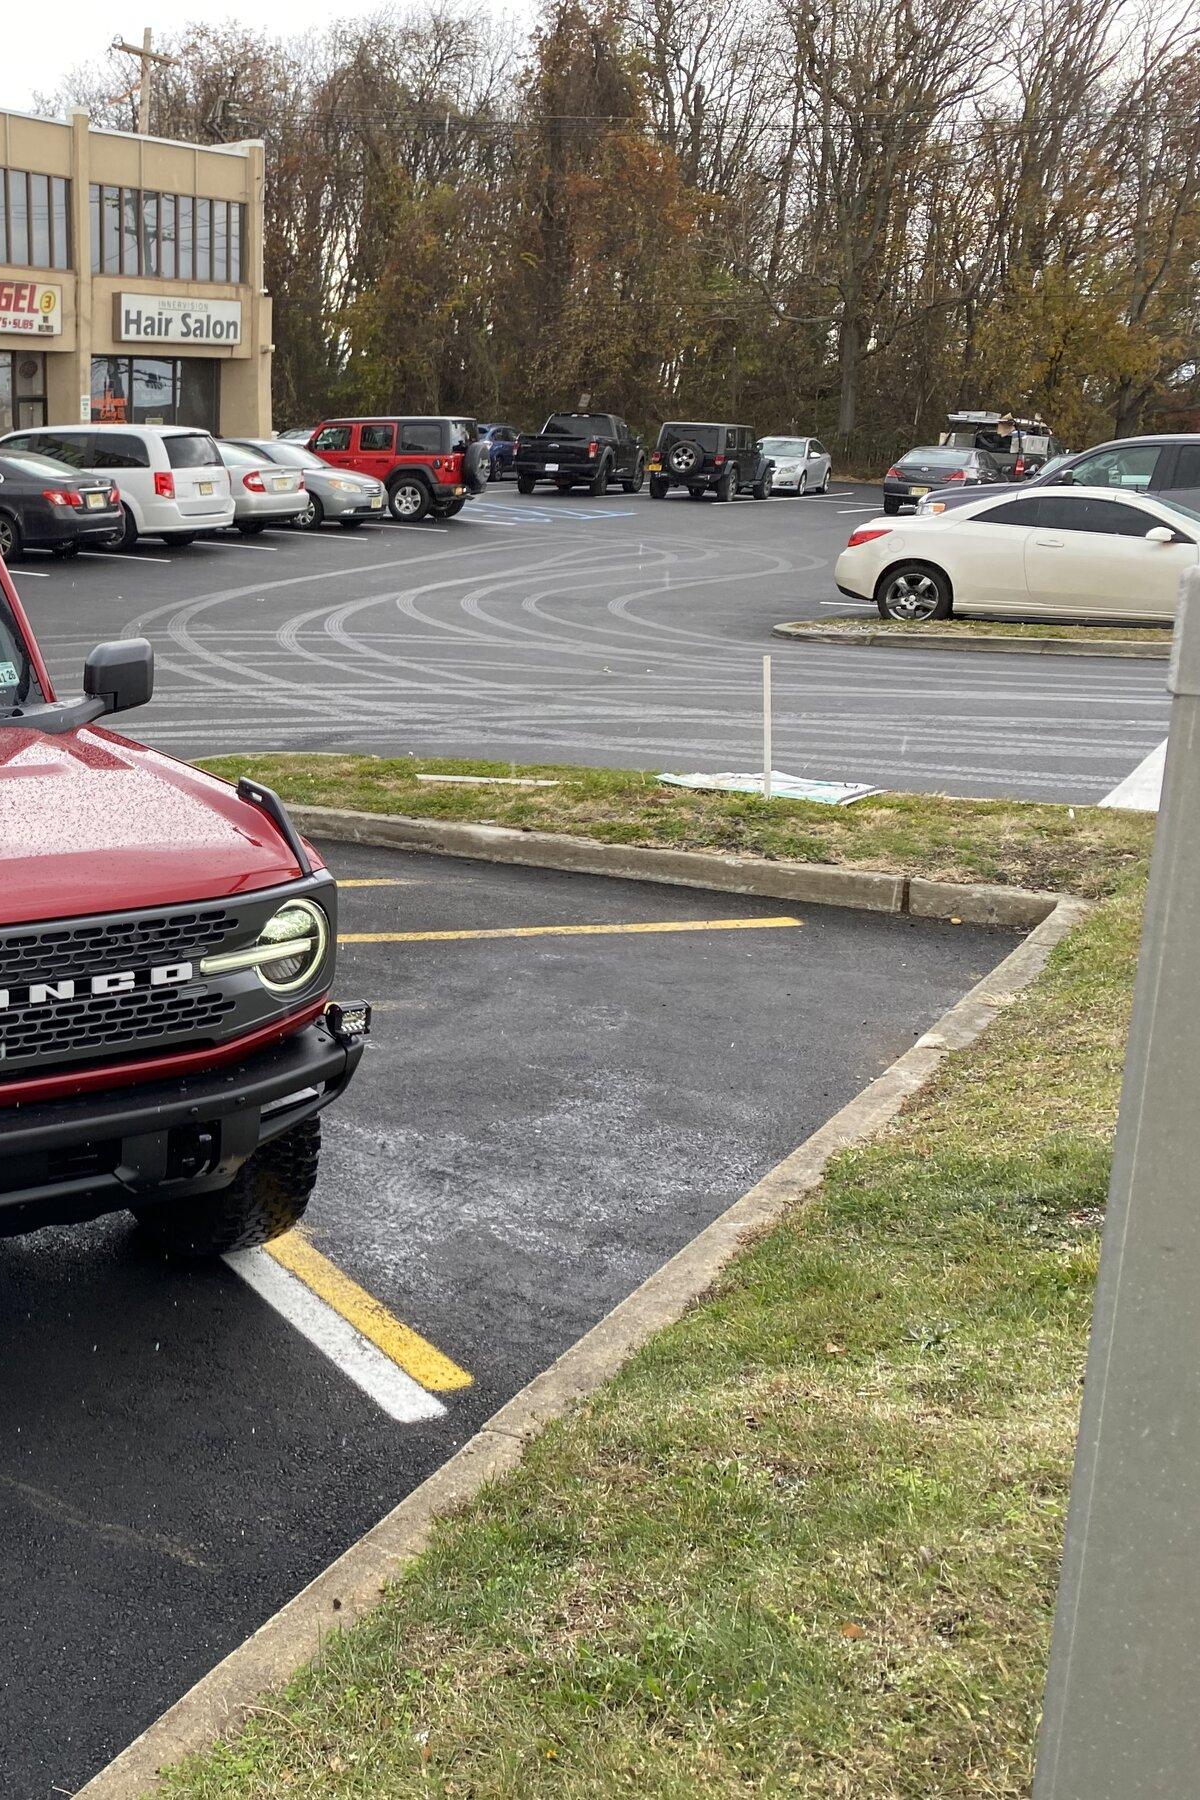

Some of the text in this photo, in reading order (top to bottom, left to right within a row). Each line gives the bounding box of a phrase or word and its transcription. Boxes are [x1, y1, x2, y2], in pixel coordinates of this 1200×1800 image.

[12, 318, 35, 330] SUBS
[123, 309, 239, 340] Hair Salon
